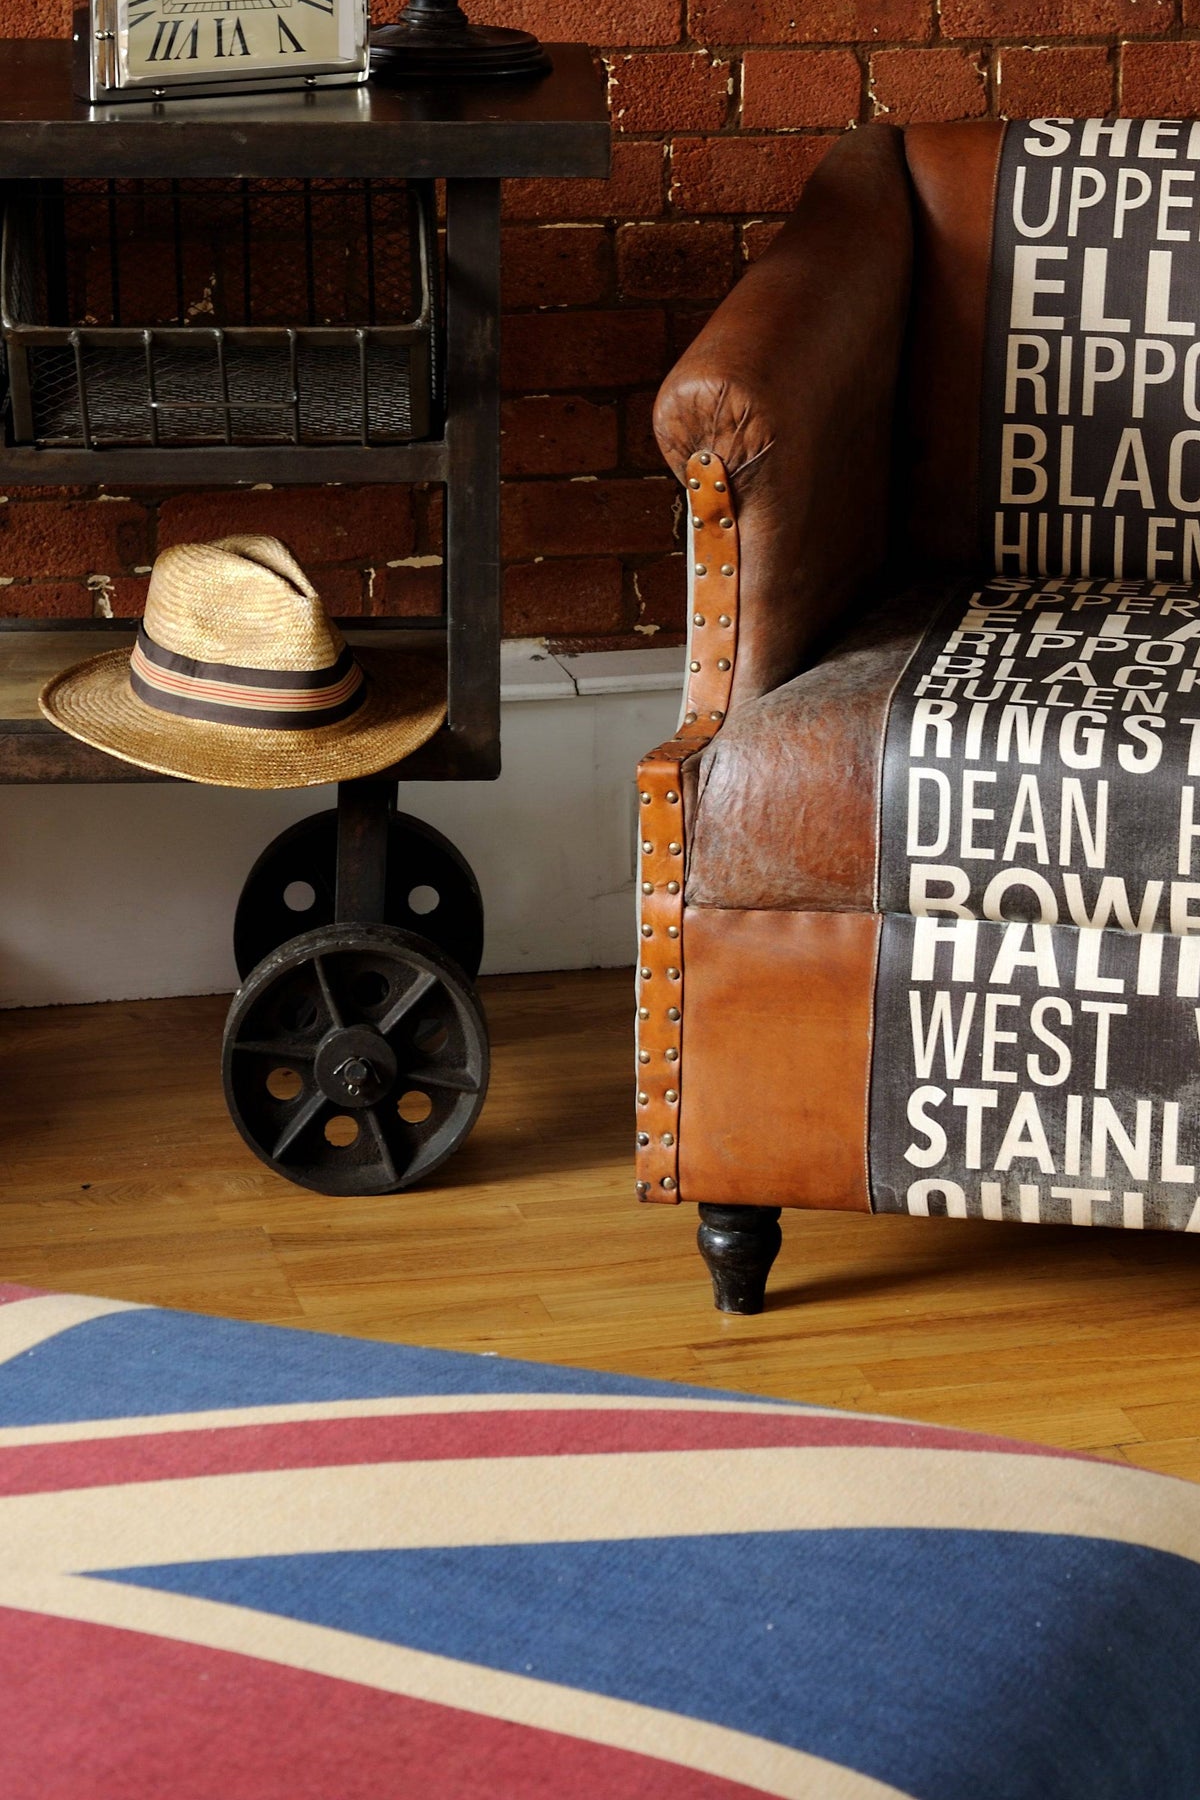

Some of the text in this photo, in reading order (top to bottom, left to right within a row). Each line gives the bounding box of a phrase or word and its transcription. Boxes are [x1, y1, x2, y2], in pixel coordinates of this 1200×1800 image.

[968, 591, 1200, 618] UPPER
[912, 675, 1169, 714] HULLEN
[906, 766, 1109, 869] DEAN
[907, 990, 1129, 1090] WEST
